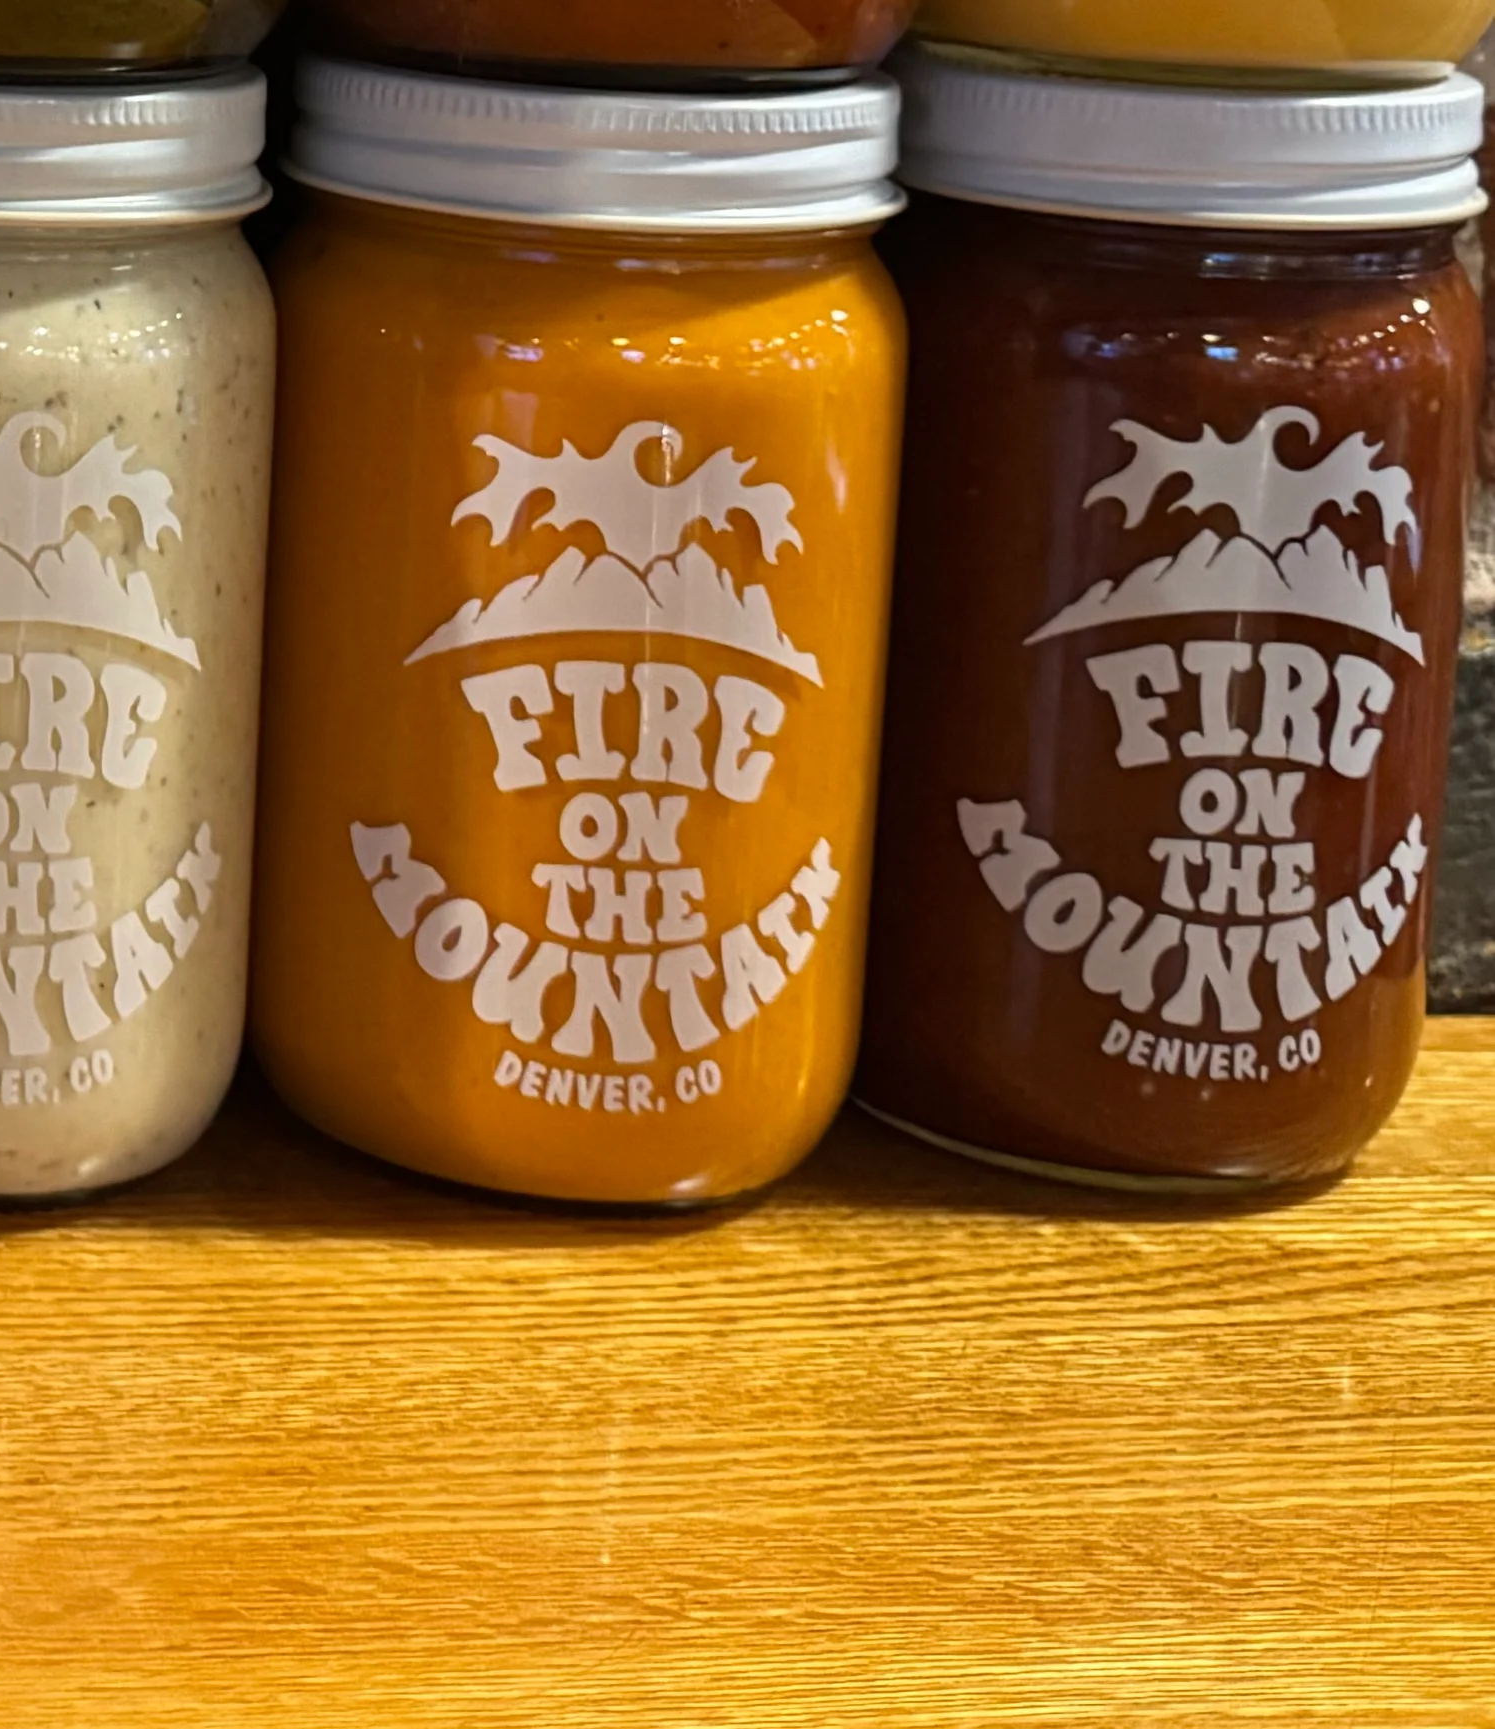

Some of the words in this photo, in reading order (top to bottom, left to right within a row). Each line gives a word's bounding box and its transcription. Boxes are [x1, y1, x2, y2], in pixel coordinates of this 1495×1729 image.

[461, 662, 784, 804] FIRE
[1087, 640, 1393, 779] FIRE
[561, 792, 687, 866] ON
[1180, 768, 1305, 840] ON
[532, 866, 706, 946] THE
[957, 796, 1427, 1036] MOUNTAIN
[1151, 836, 1317, 917] THE
[349, 820, 840, 1063] MOUNTAIN
[69, 1050, 115, 1093] CO
[491, 1050, 666, 1116] DENVER,
[675, 1059, 723, 1102] CO
[1102, 1017, 1269, 1084] DENVER,
[1278, 1029, 1322, 1072] CO
